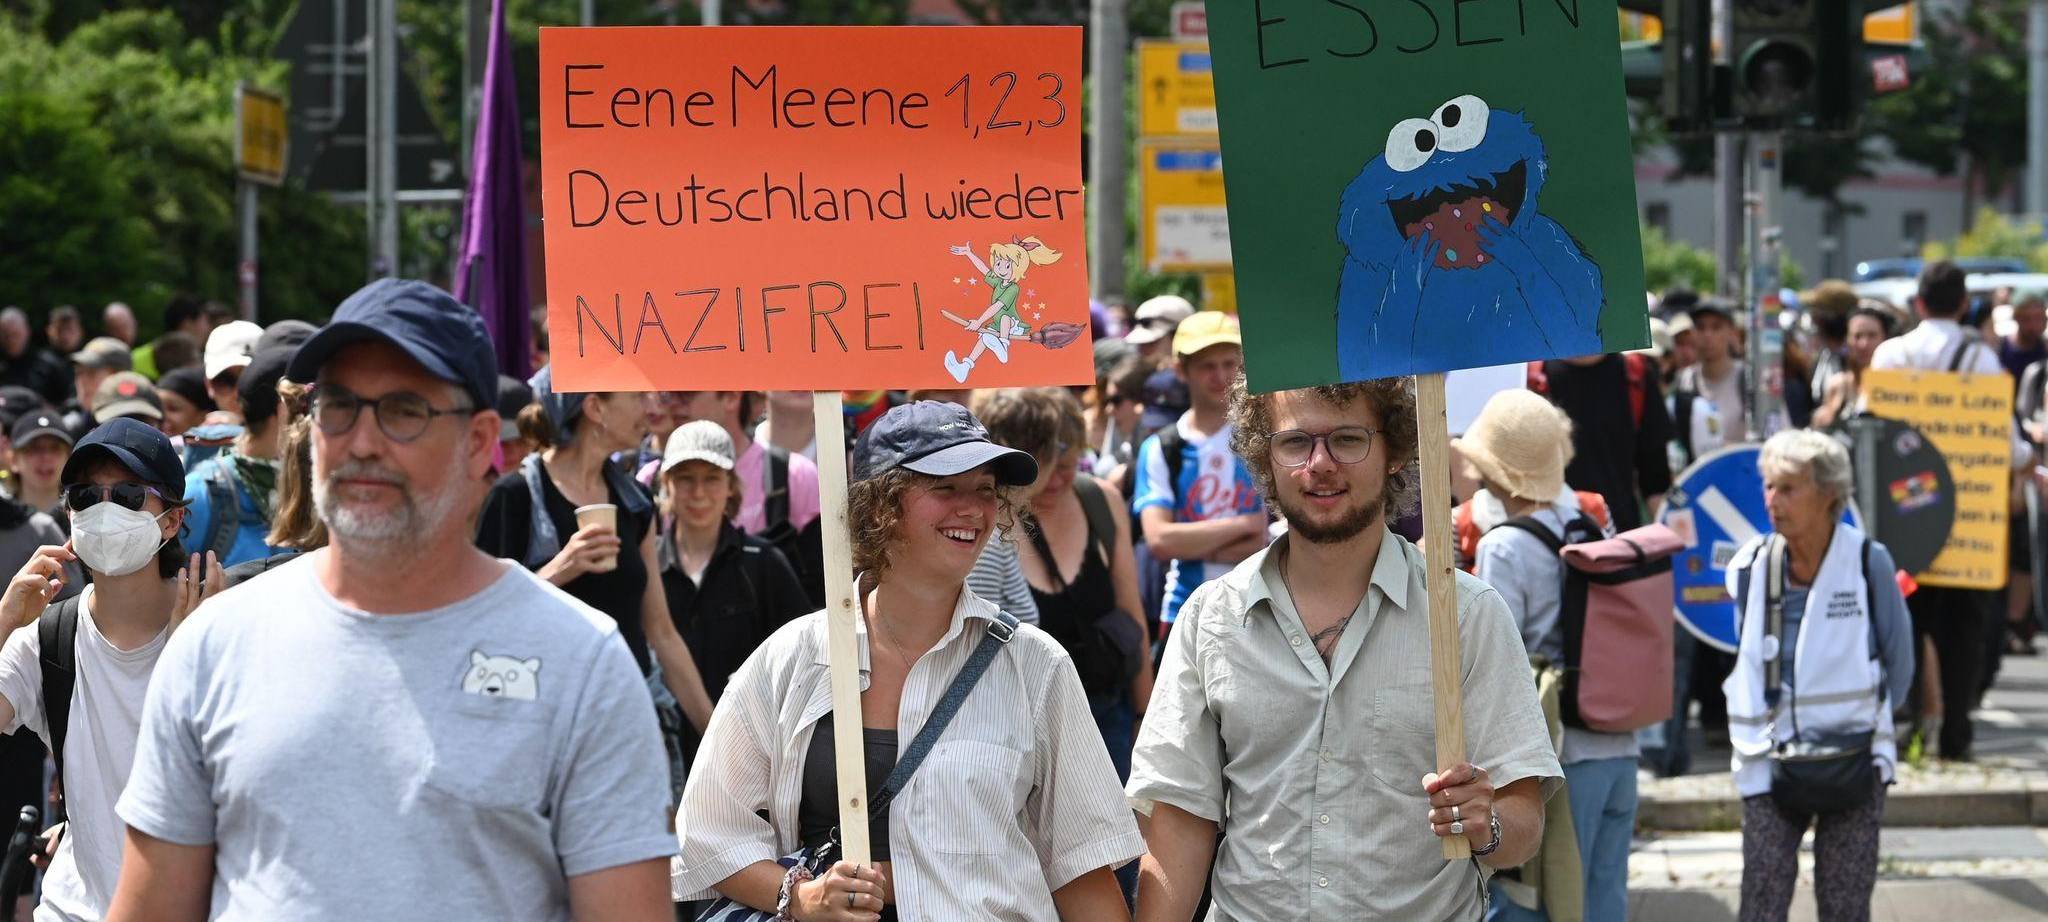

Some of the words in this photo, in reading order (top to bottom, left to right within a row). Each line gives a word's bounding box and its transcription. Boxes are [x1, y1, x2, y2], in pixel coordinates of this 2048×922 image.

[565, 64, 715, 128] Eene
[731, 64, 929, 129] Meene
[944, 71, 1066, 139] 1,2,3
[568, 169, 907, 228] Deutschland
[925, 172, 1080, 221] wieder
